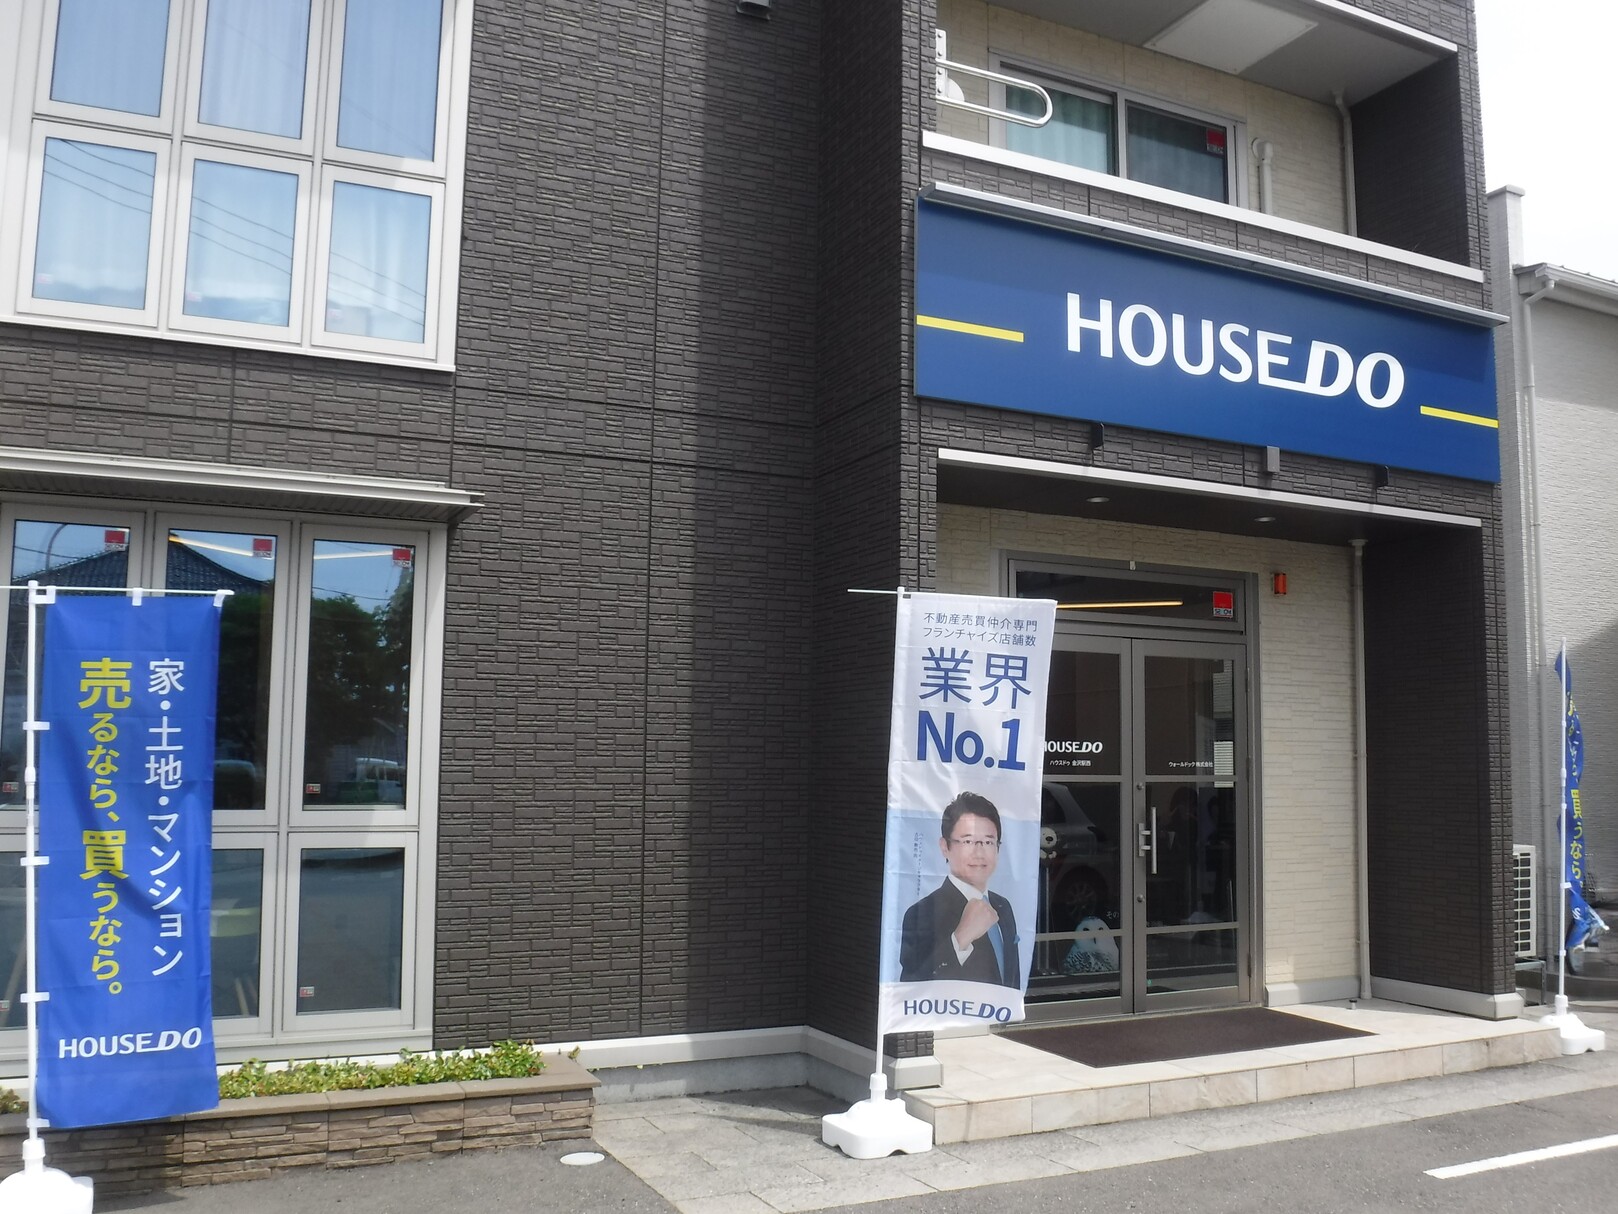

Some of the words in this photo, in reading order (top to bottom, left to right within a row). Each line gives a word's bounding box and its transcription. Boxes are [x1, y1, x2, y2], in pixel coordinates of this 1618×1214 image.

[922, 627, 1037, 647] フランチャイズ店舗数
[923, 612, 1038, 632] 不動産売買仲介専門
[919, 647, 1031, 709] 業界
[917, 710, 1026, 771] No.1
[78, 657, 132, 995] 売るなら、買うなら。
[144, 658, 185, 976] 家・土地・マンション
